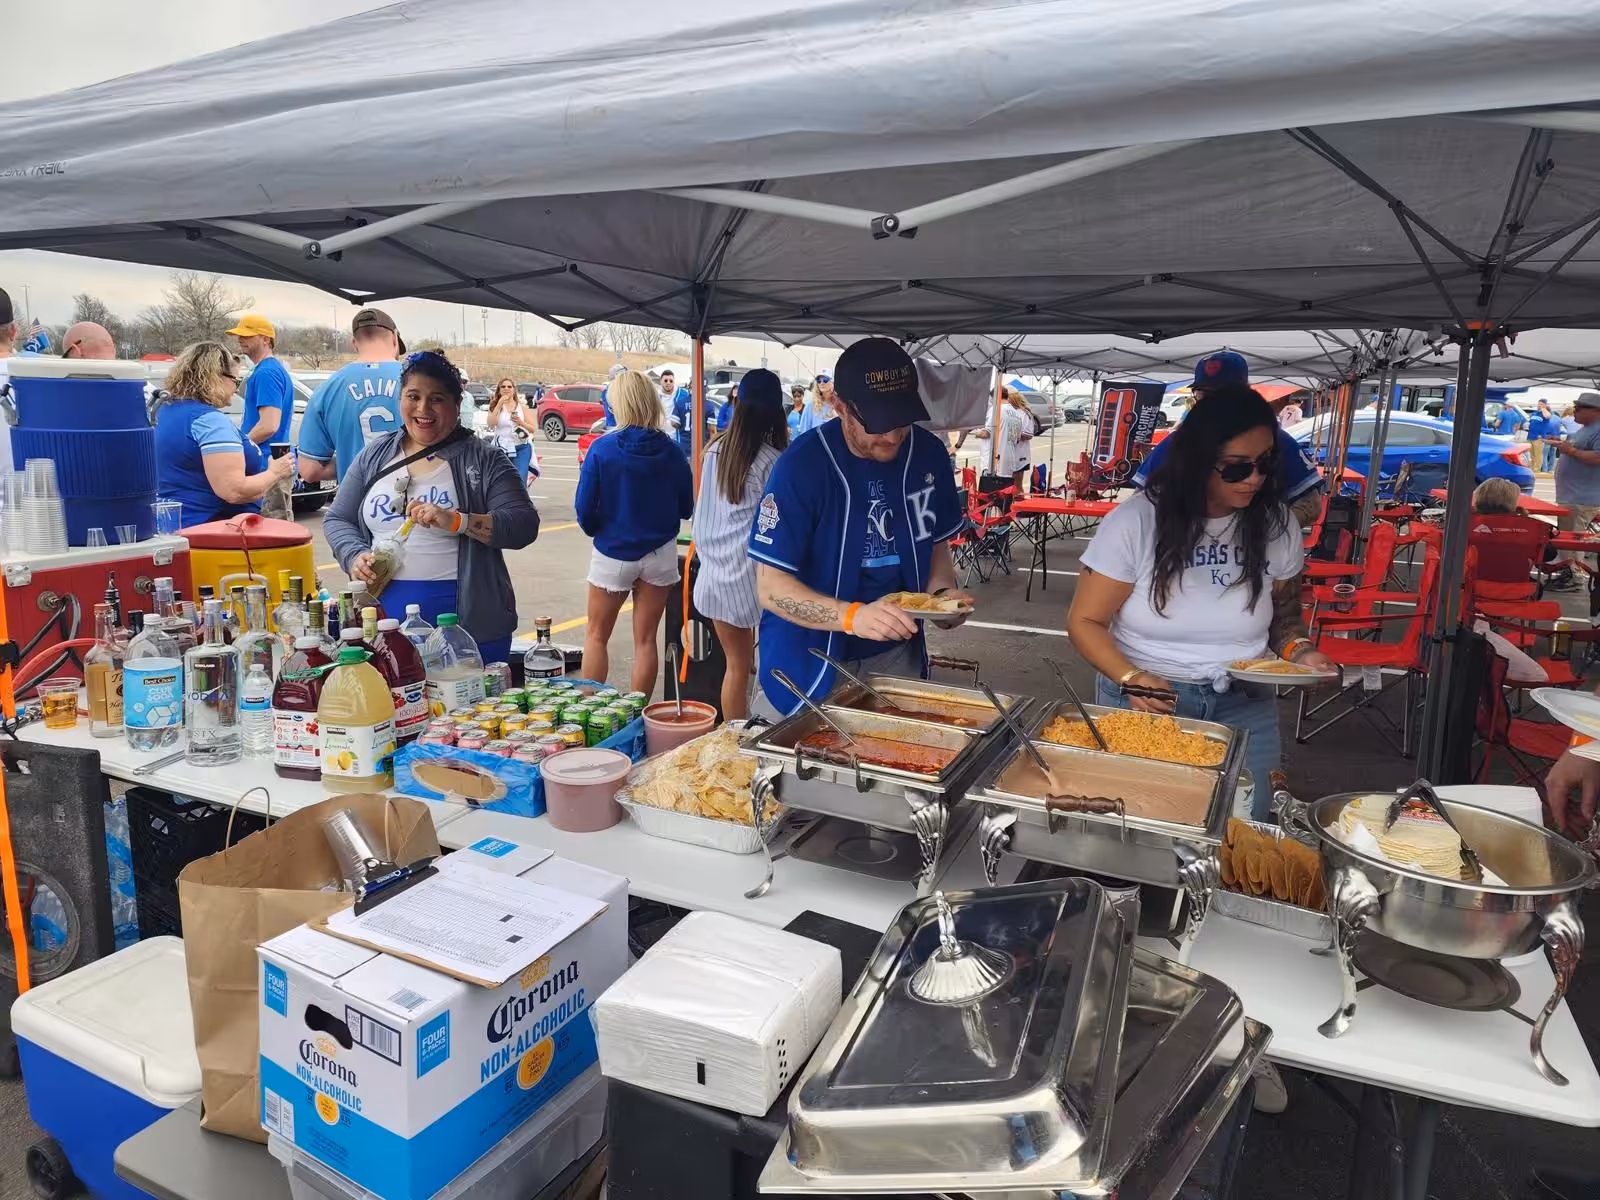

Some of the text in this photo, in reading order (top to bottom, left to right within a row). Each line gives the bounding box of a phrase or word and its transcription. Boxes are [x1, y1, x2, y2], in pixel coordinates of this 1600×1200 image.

[348, 378, 397, 401] CAIN
[864, 369, 899, 384] COWBOY
[1133, 405, 1153, 443] MACHINE
[370, 486, 453, 522] Rals
[867, 500, 895, 542] KC
[1211, 569, 1231, 588] KC
[147, 692, 174, 702] SODA
[268, 973, 285, 991] FOUR
[487, 961, 578, 1043] Corona
[422, 1026, 446, 1049] FOUR
[480, 988, 585, 1083] NON-ALCOHOLIC
[299, 1039, 358, 1088] Corona
[296, 1062, 362, 1113] NON-ALCOHOLIC
